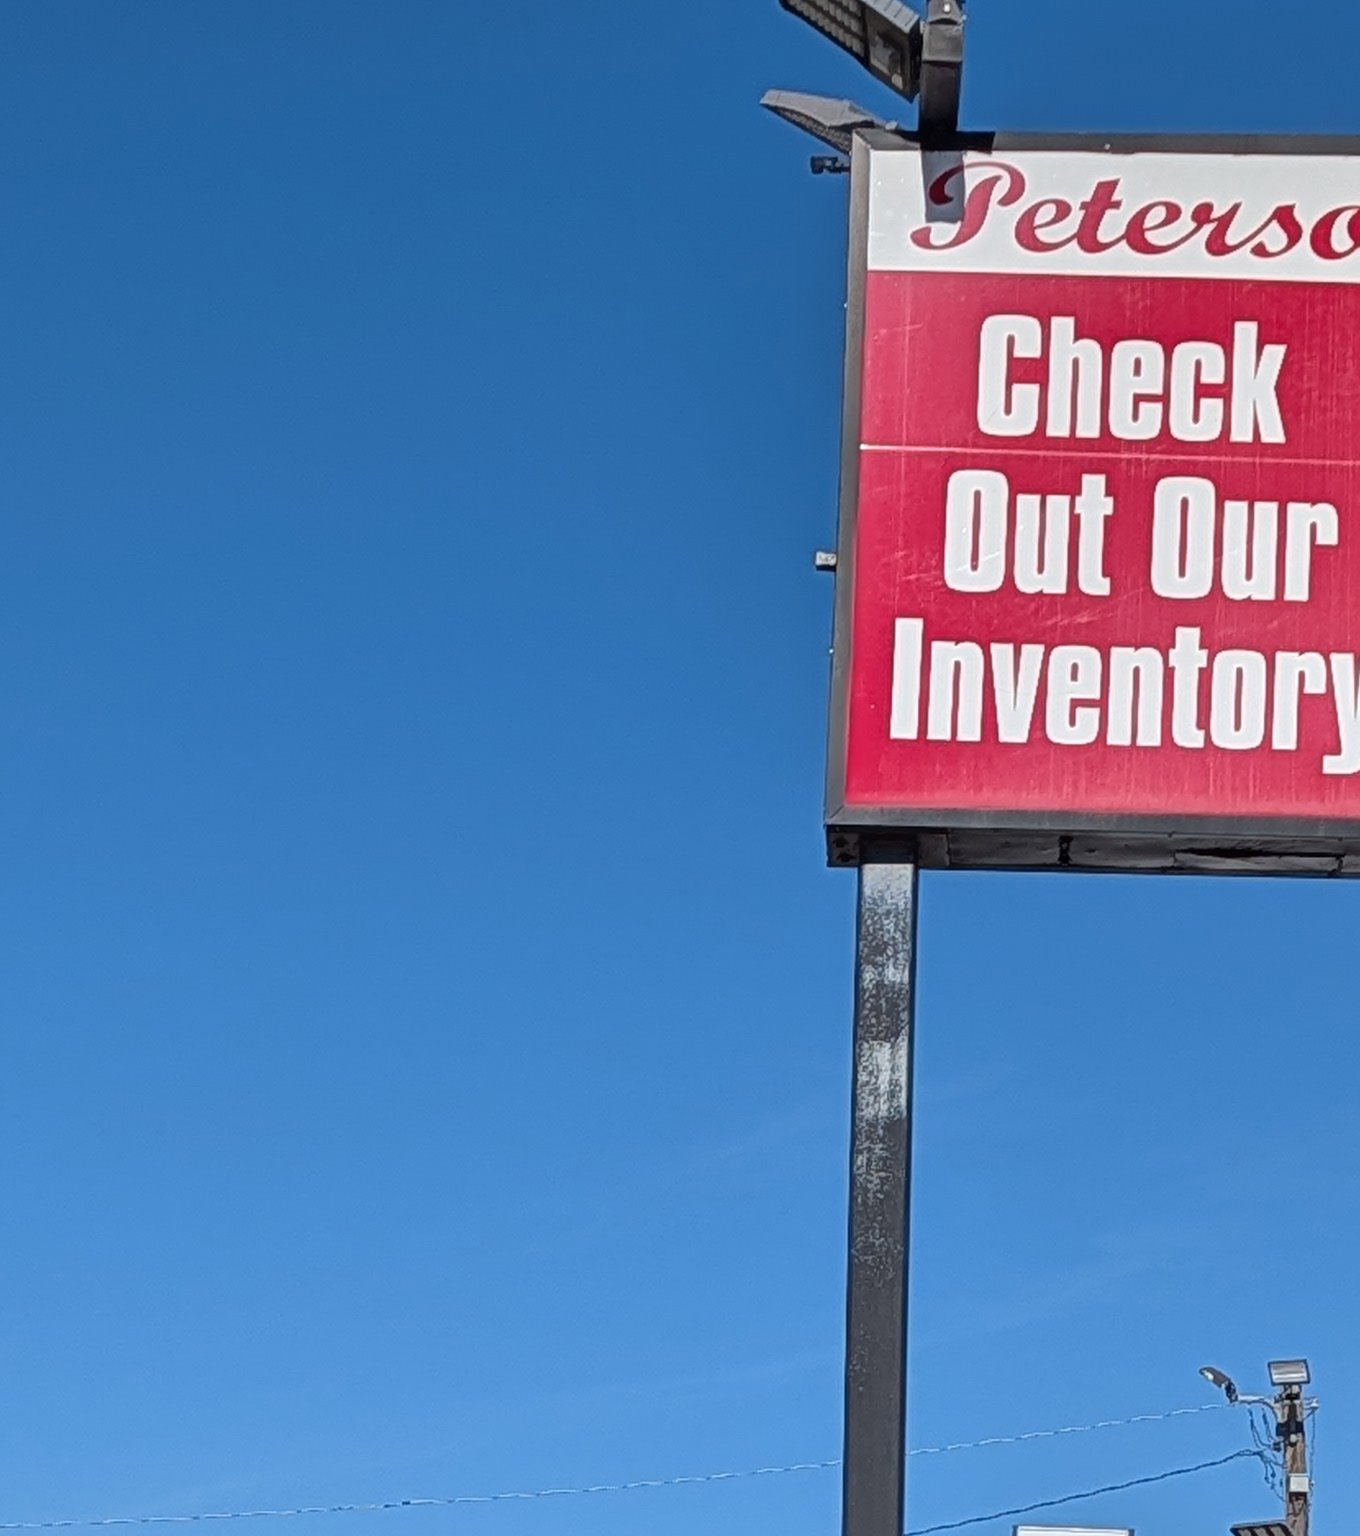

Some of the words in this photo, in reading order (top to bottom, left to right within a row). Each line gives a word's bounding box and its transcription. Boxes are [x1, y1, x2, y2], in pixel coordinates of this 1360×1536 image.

[976, 314, 1288, 444] Check
[943, 469, 1114, 596] Out
[1150, 476, 1339, 602] Our
